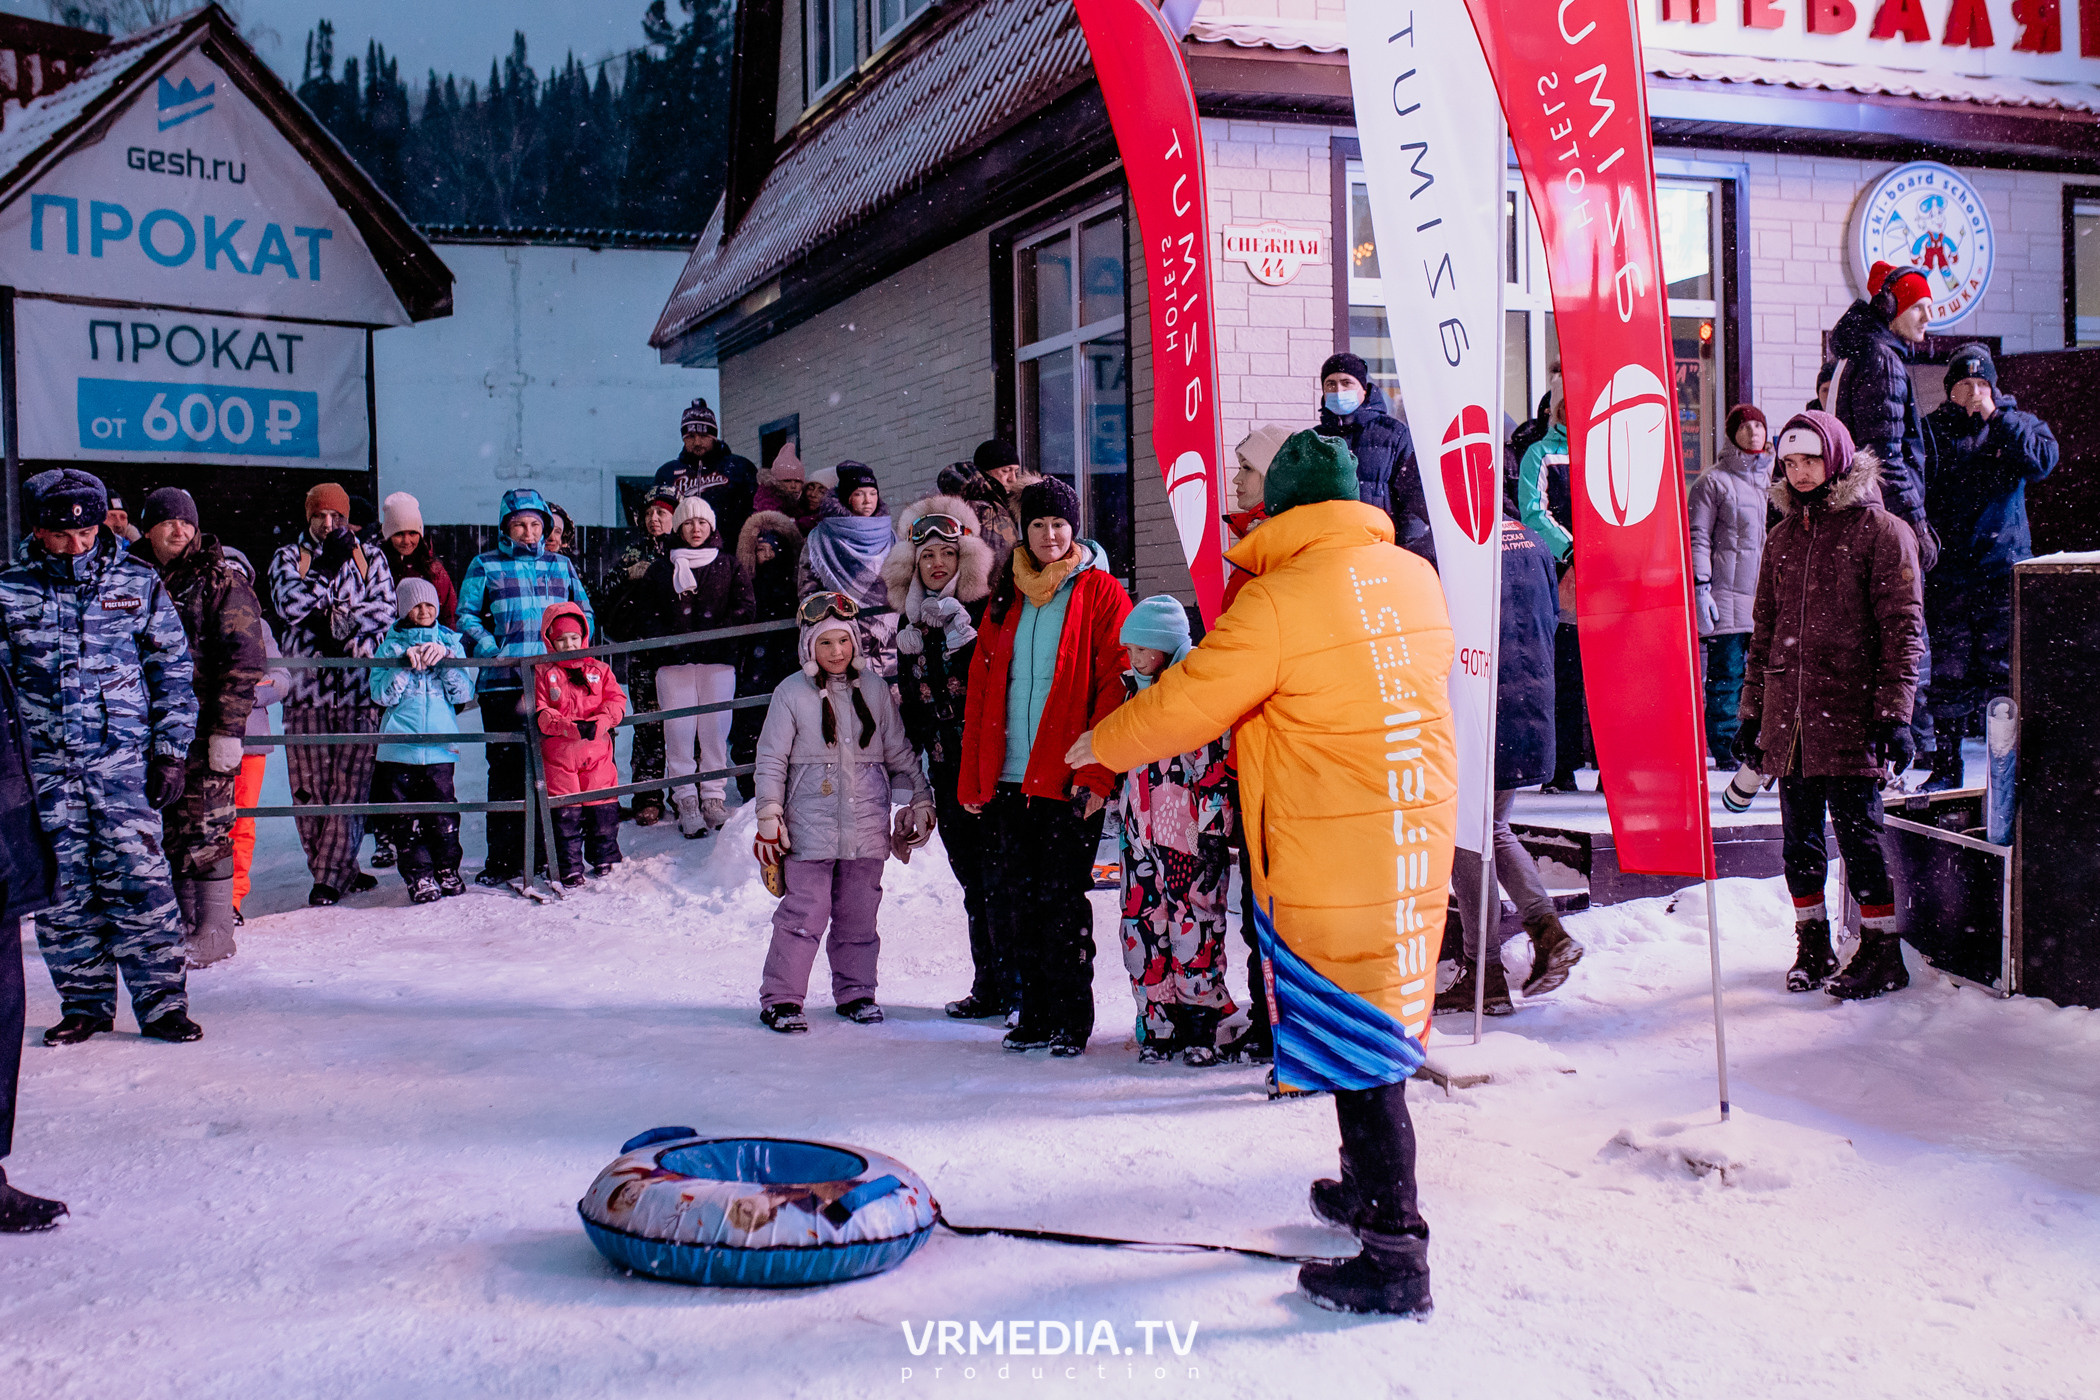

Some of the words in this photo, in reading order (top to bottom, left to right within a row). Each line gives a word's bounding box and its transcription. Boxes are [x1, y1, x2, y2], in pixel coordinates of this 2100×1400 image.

[1872, 172, 1934, 236] ski-board
[1943, 179, 1985, 235] school
[30, 193, 333, 282] ПРОКАТ
[1227, 236, 1318, 255] СНЕЖНАЯ
[1260, 258, 1284, 277] 44
[89, 320, 303, 375] ПРОКАТ
[678, 472, 728, 495] Russia
[1348, 566, 1418, 703] FEST
